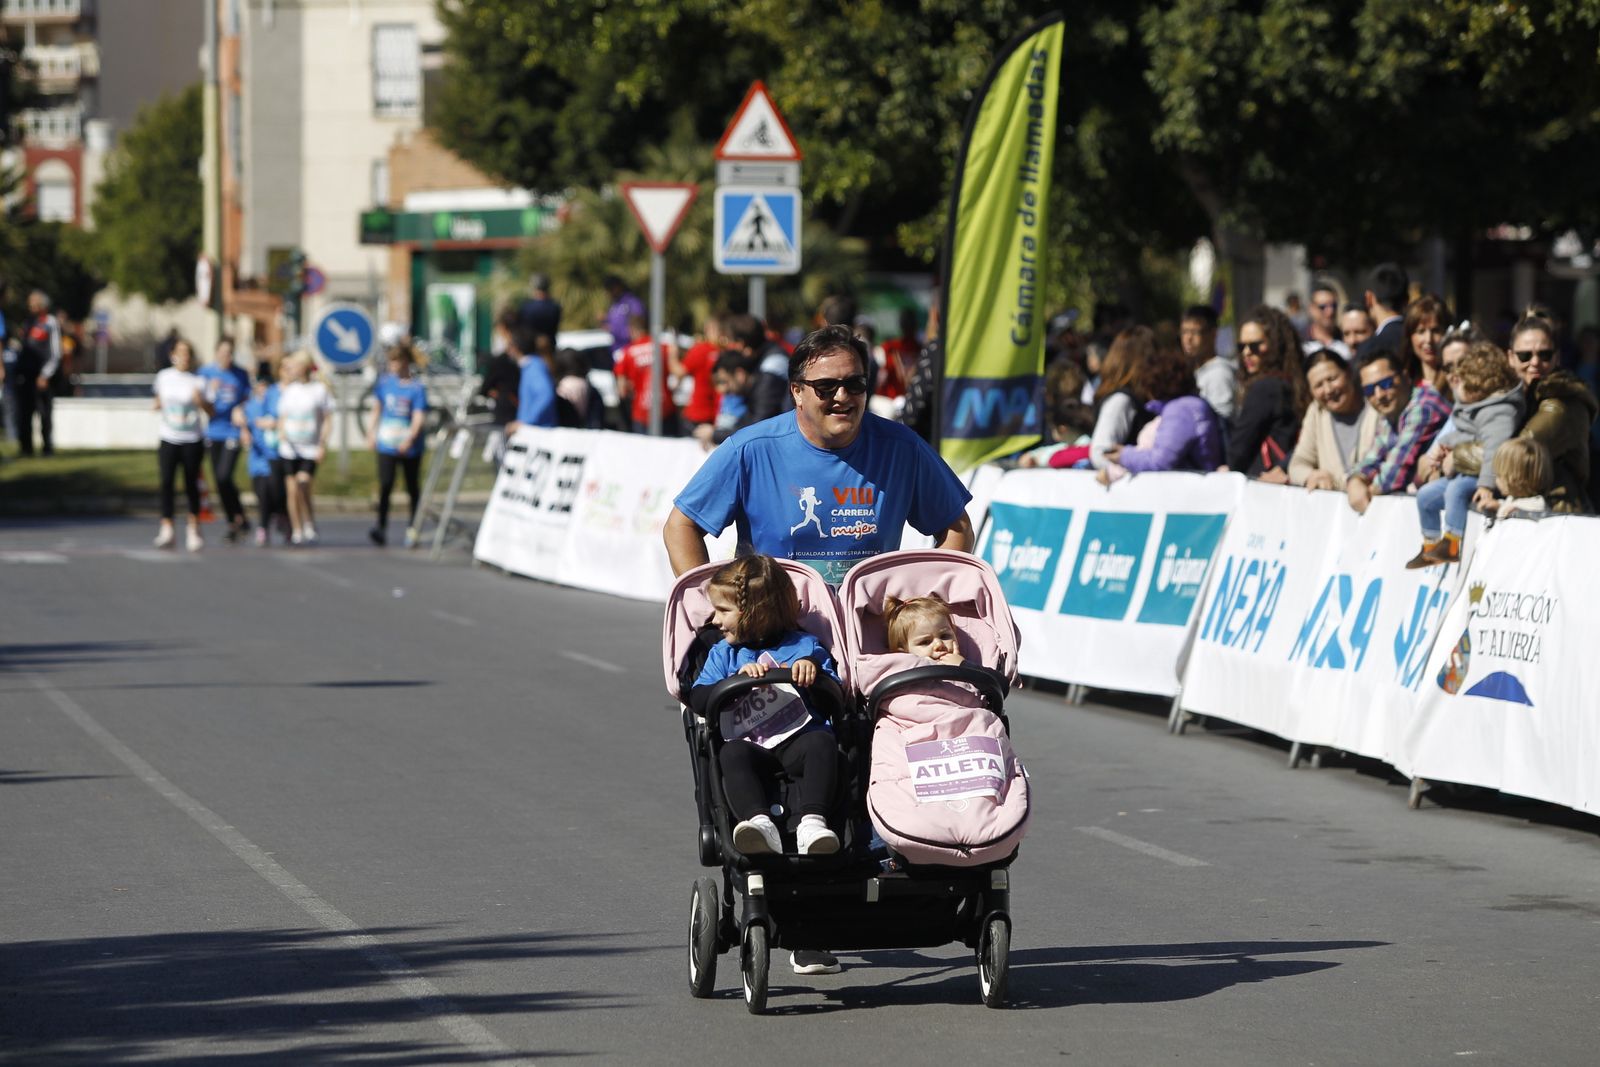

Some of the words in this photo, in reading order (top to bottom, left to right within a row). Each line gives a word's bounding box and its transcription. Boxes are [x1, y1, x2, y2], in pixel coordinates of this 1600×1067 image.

[1019, 49, 1049, 183] llamadas
[1017, 192, 1039, 226] de
[1011, 235, 1037, 347] Cámara
[832, 487, 873, 505] VIII
[1201, 554, 1286, 653] NEXA
[747, 711, 768, 726] PAULA
[916, 757, 1001, 779] ATLETA
